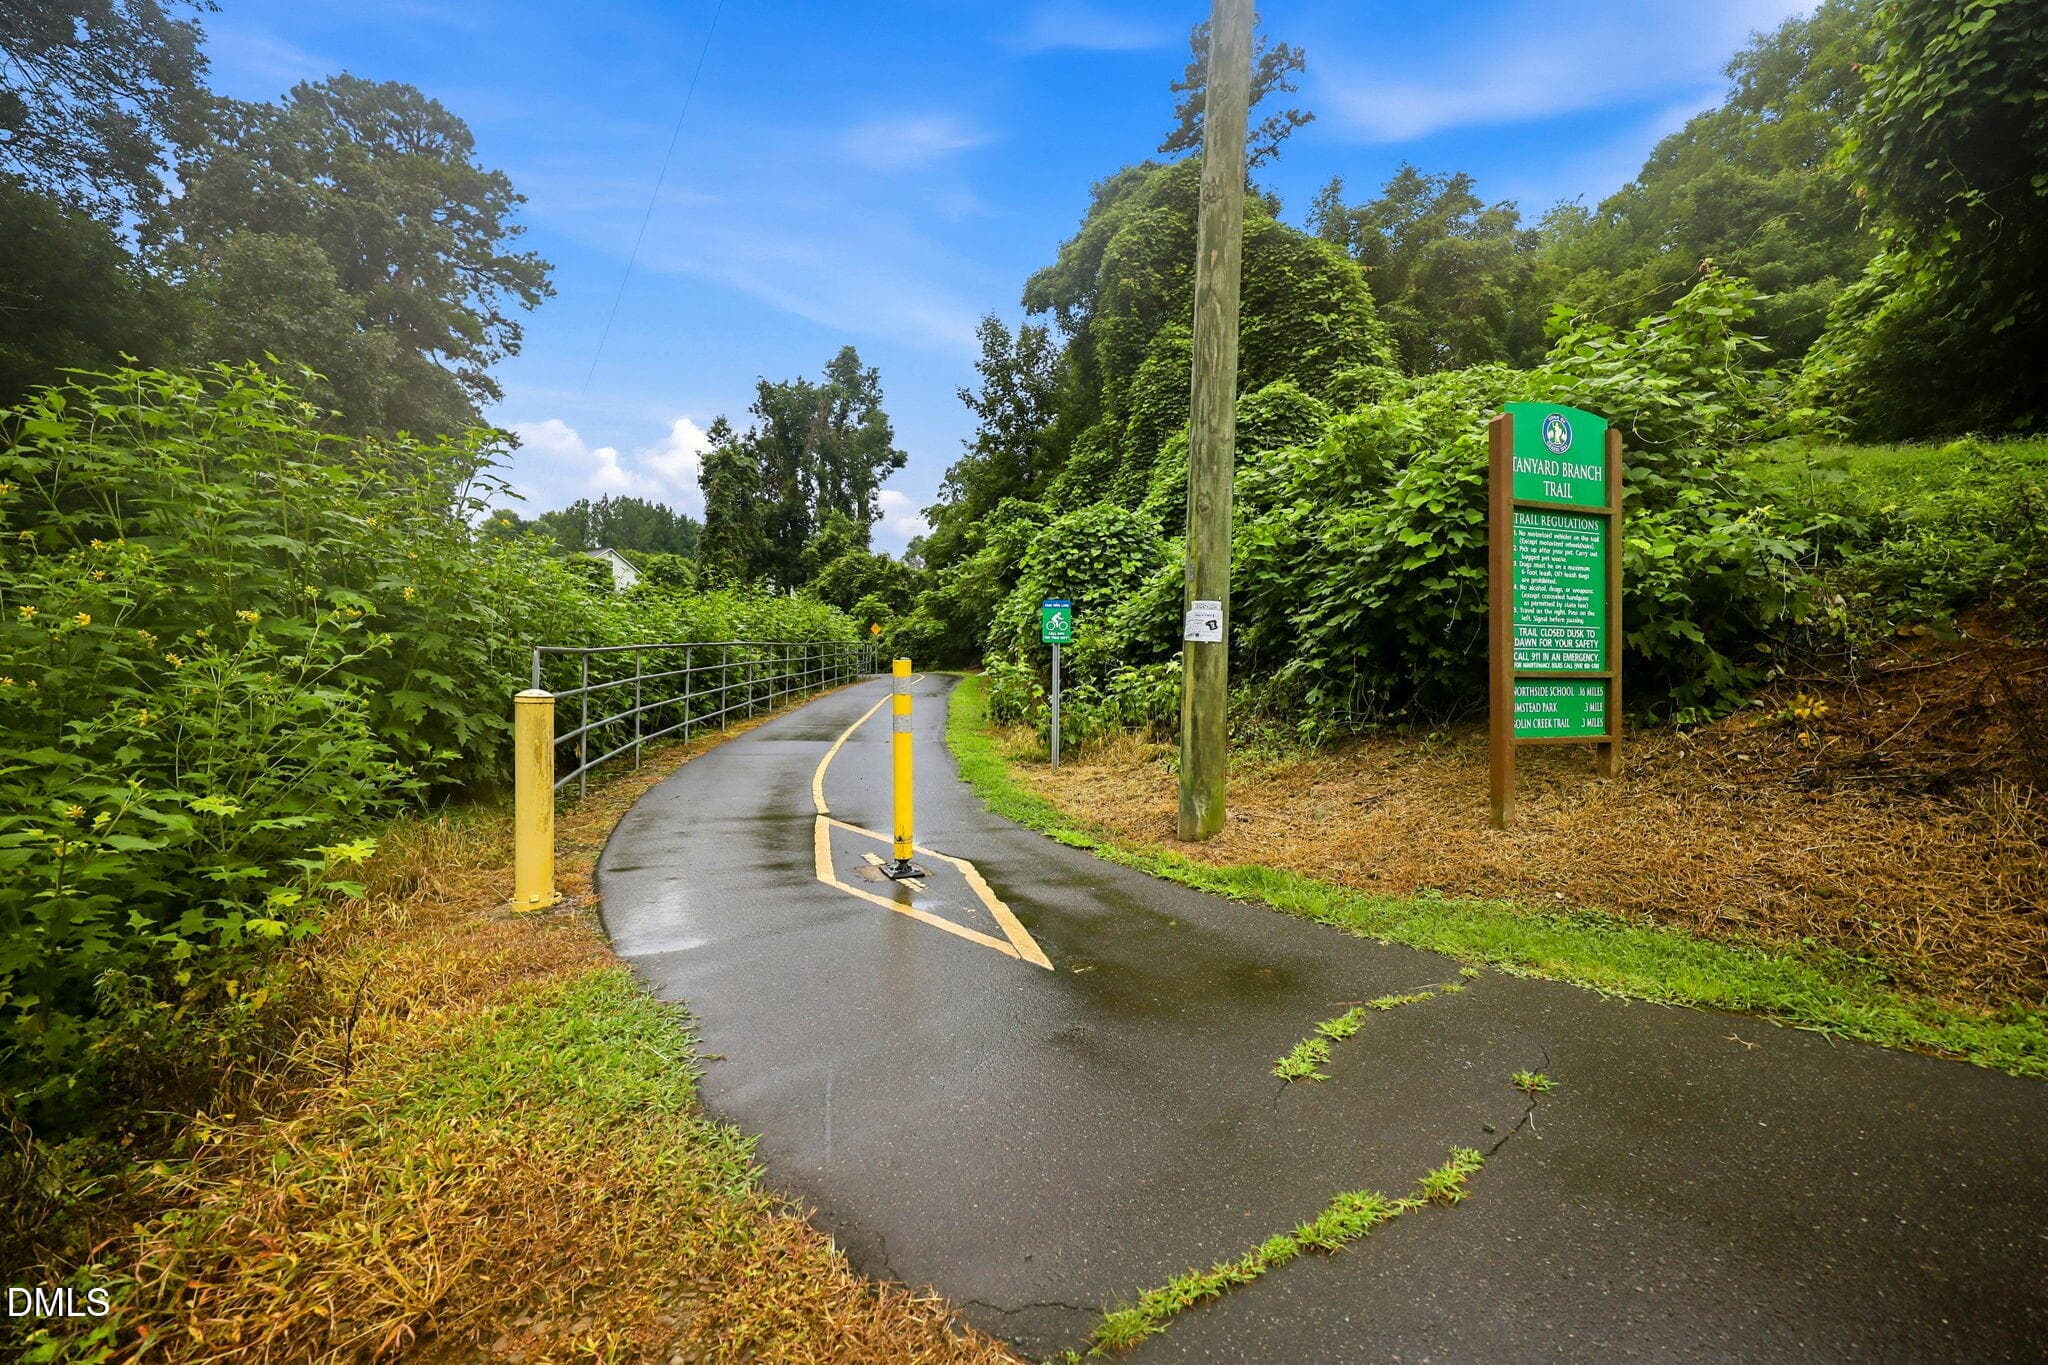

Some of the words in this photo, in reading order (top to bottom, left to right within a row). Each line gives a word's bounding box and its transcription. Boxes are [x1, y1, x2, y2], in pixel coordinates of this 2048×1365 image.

[1513, 456, 1559, 476] TANYARD
[1562, 462, 1602, 481] BRANCH
[1543, 480, 1572, 498] TRAIL
[1513, 512, 1539, 525] TRAIL
[1542, 515, 1598, 530] REGULATIONS
[1533, 615, 1547, 623] Signal
[1519, 627, 1538, 636] TRAIL
[1540, 628, 1565, 637] CLOSED
[1567, 629, 1584, 638] DUSK
[1586, 630, 1595, 638] TO
[1514, 638, 1537, 647] DAWN
[1539, 639, 1552, 647] FOR
[1554, 639, 1573, 647] YOUR
[1575, 640, 1598, 648] SAFETY
[1513, 652, 1529, 660] CALL
[1531, 653, 1540, 661] 911
[1543, 653, 1549, 661] IN
[1551, 653, 1560, 661] AN
[1562, 653, 1600, 662] EMERGENCY.
[1550, 686, 1574, 696] SCHOOL
[1586, 686, 1603, 696] MILES
[1542, 702, 1557, 712] PARK
[1590, 702, 1603, 711] MILE
[1533, 719, 1552, 728] CREEK
[1553, 719, 1570, 728] TRAIL
[1586, 718, 1603, 727] MILES
